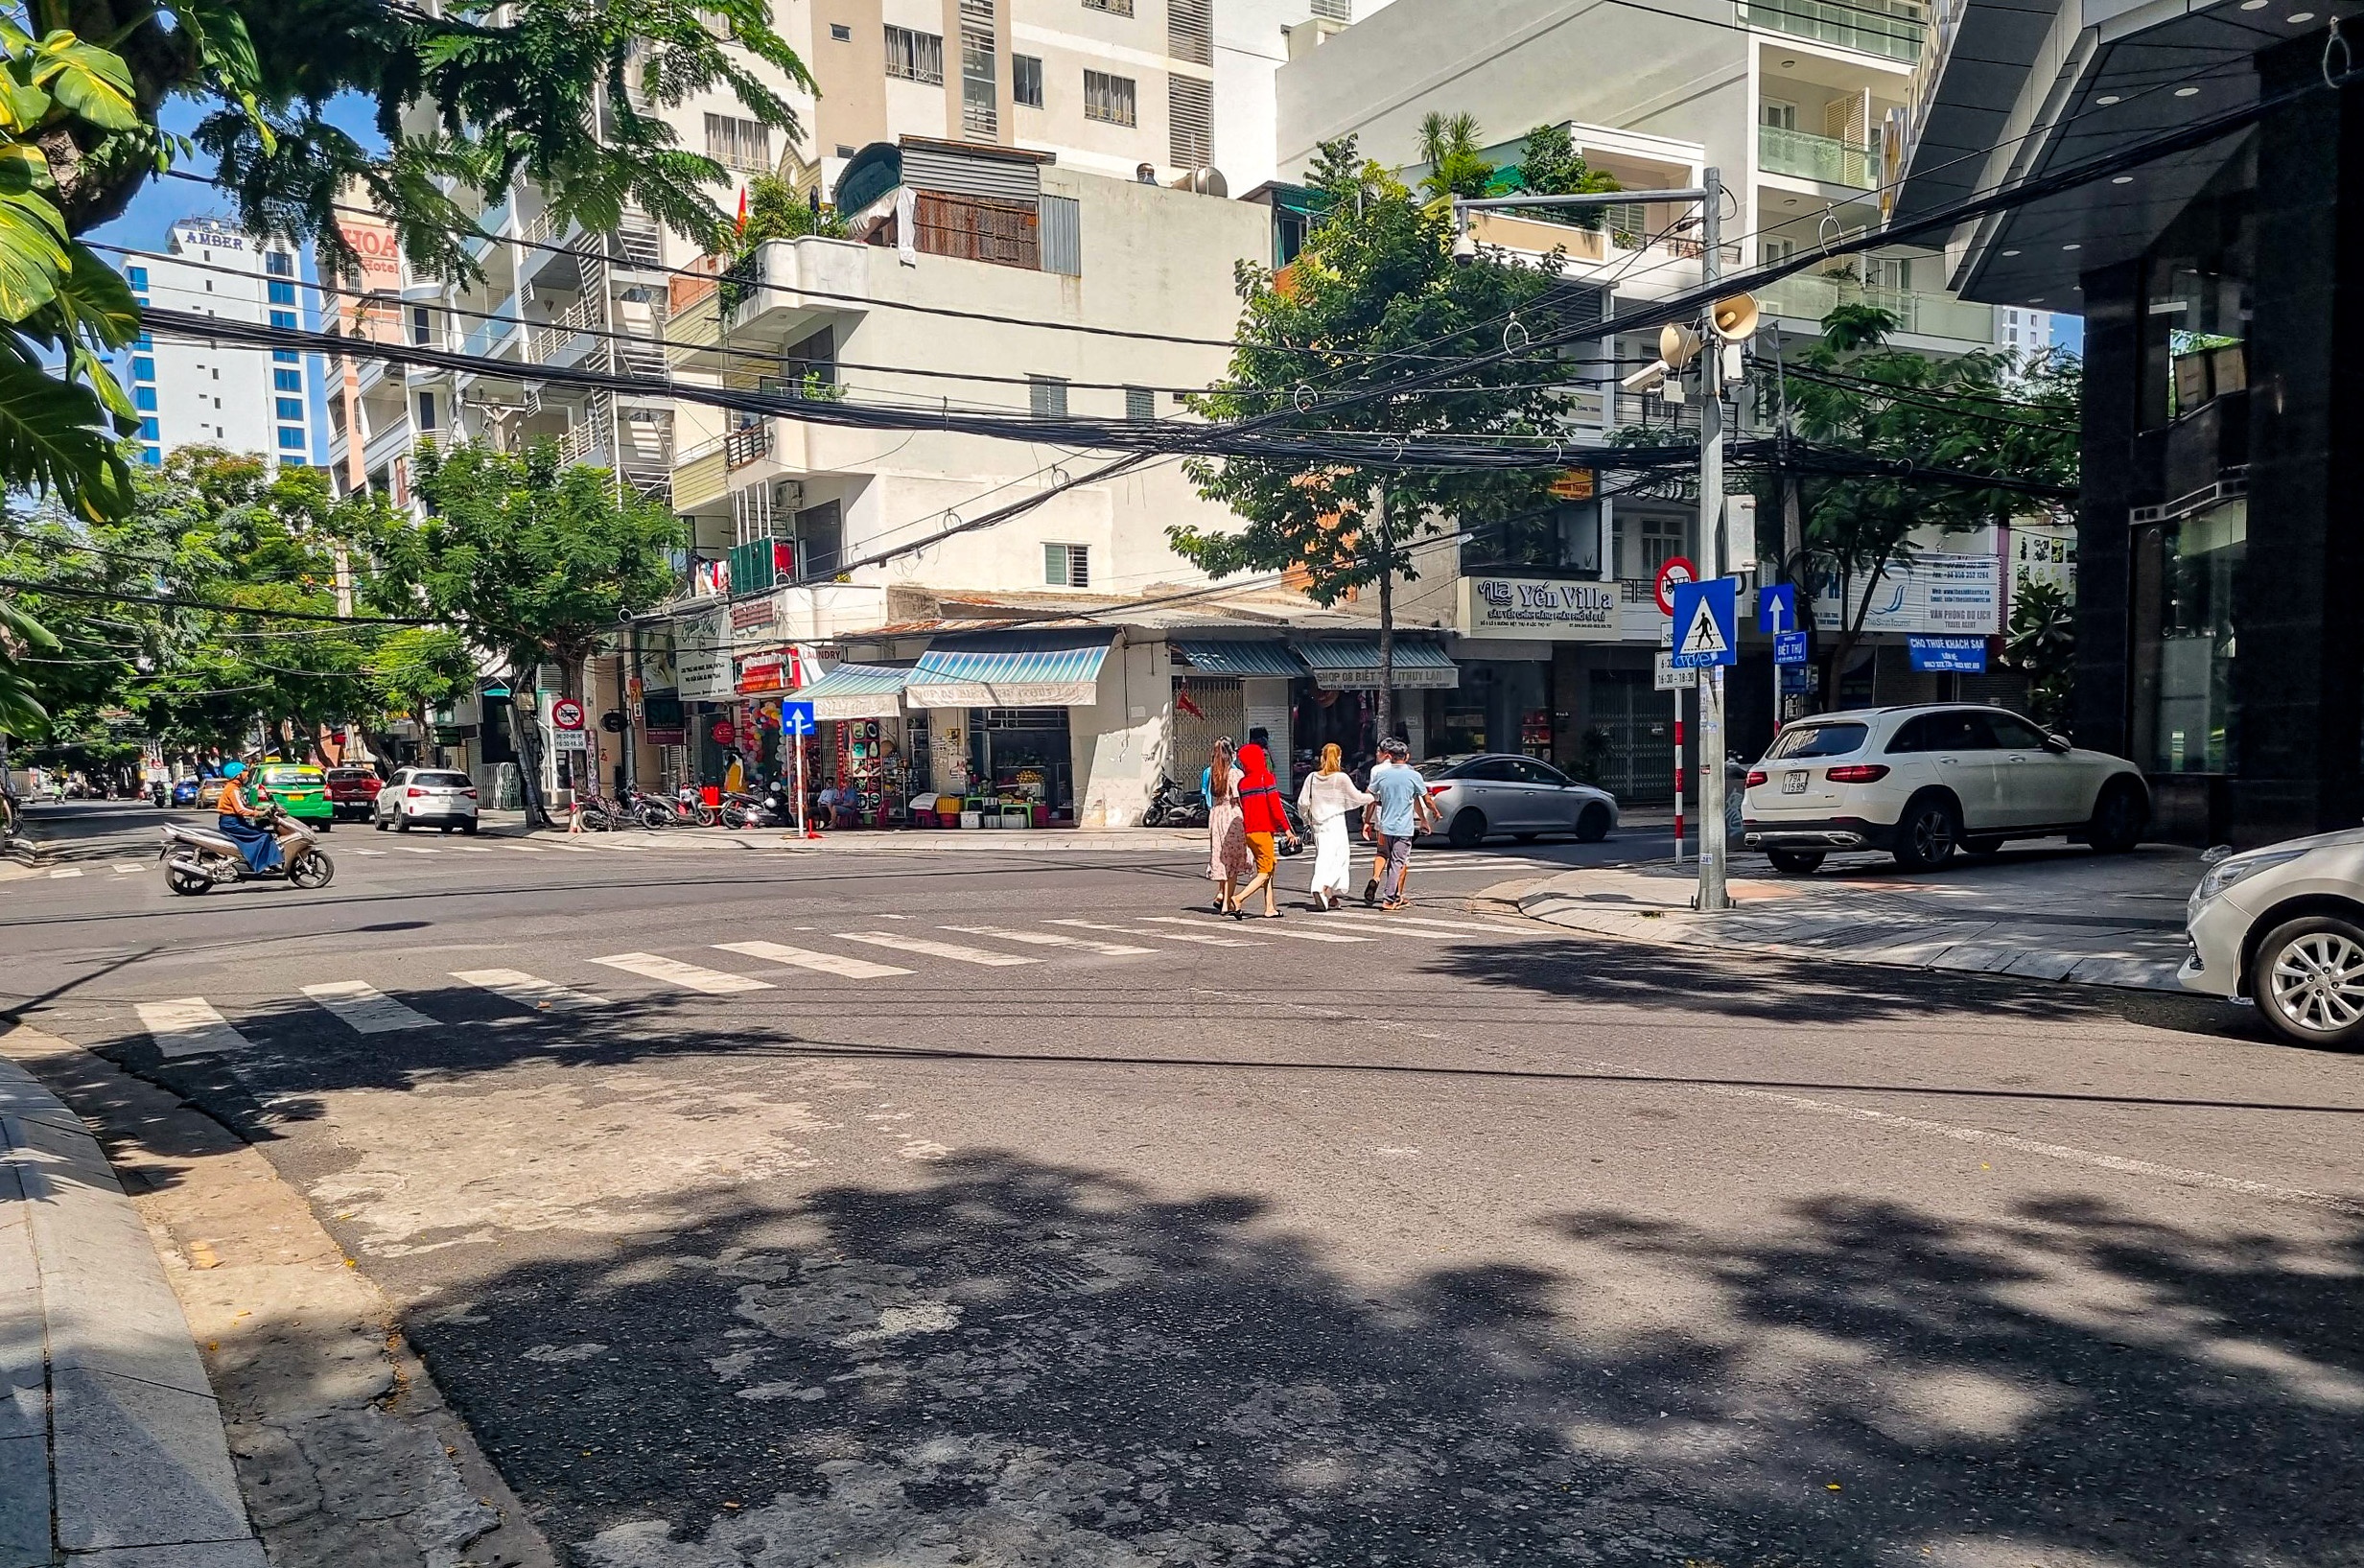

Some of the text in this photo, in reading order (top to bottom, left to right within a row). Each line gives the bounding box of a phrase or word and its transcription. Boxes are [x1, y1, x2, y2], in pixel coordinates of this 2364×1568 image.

[185, 231, 244, 250] AMBER
[363, 260, 399, 274] Hotel
[1517, 580, 1558, 608] Yến
[1560, 586, 1613, 609] Villa
[1967, 610, 1976, 620] DU
[1909, 638, 1926, 648] CHO
[804, 650, 841, 660] LAUNDRY
[1317, 671, 1340, 682] SHOP
[1342, 672, 1353, 682] 08
[1658, 673, 1674, 685] 16:30
[1679, 671, 1694, 683] 18:30
[1789, 773, 1801, 784] 79A
